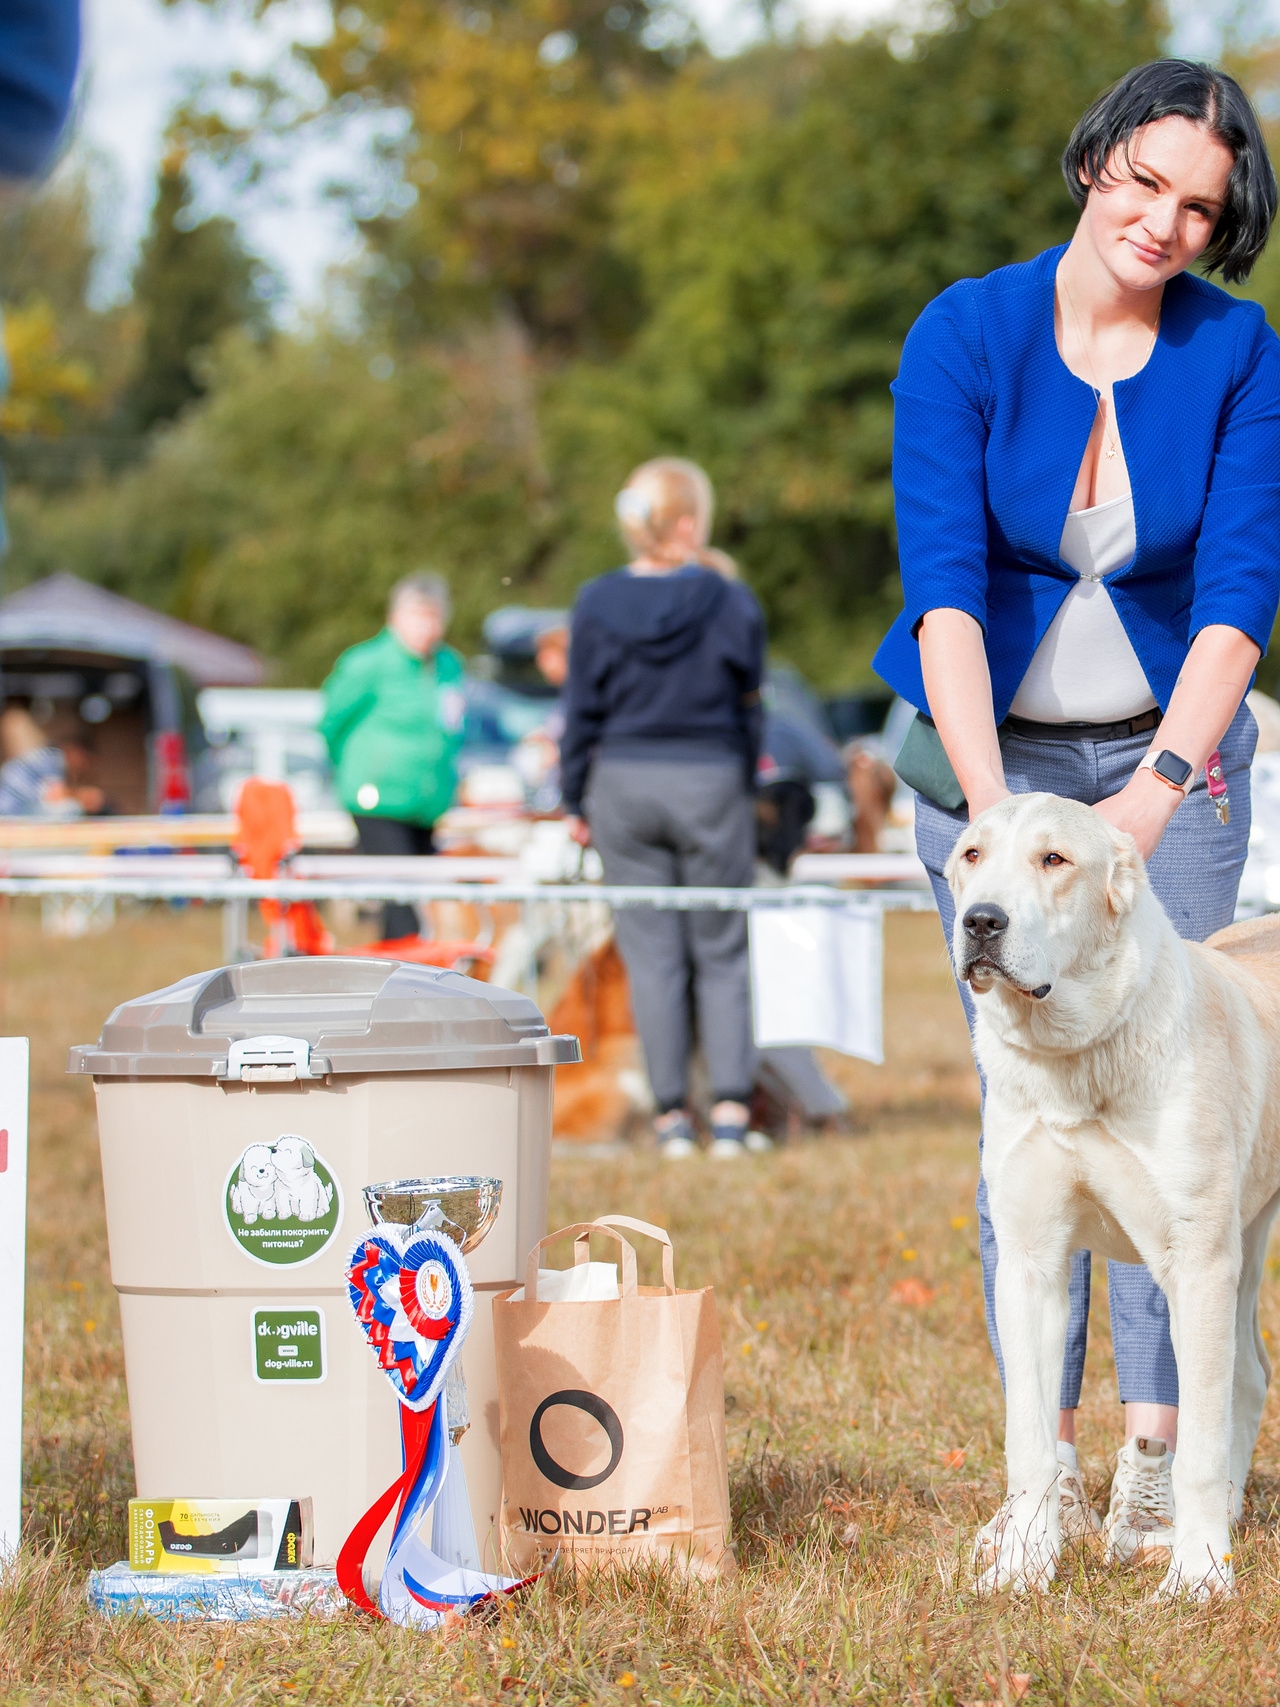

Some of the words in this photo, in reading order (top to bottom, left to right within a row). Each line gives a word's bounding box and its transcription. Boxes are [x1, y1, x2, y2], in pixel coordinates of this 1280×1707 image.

[237, 1228, 249, 1237] Не
[250, 1228, 281, 1237] забыли
[282, 1228, 330, 1238] покормить
[262, 1239, 304, 1248] питомца?
[264, 1358, 313, 1370] dog-ville.ru
[518, 1507, 652, 1535] WONDER
[651, 1505, 669, 1515] LAB
[145, 1508, 155, 1564] ФОНАРЬ
